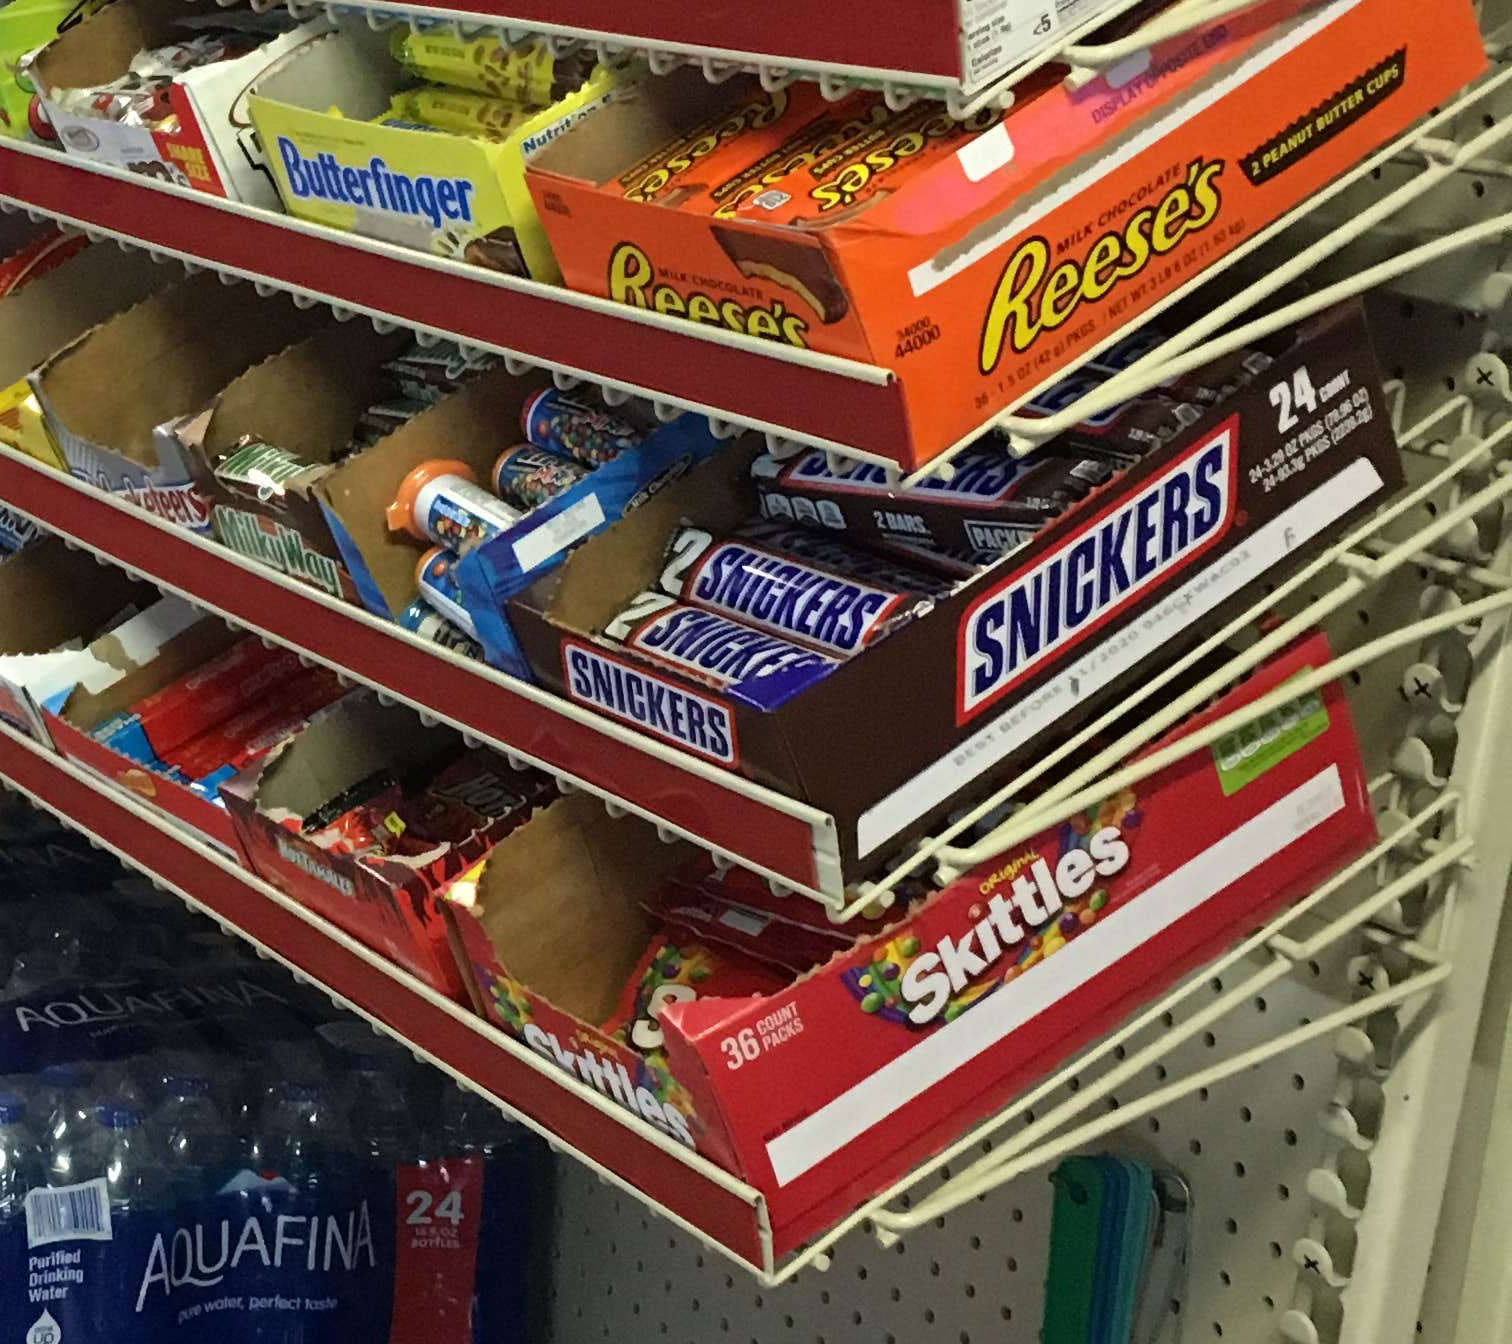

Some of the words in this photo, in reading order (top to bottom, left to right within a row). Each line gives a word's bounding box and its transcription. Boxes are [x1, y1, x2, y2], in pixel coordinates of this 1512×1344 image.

[1091, 83, 1145, 125] DISPLAY
[1252, 163, 1261, 176] 2
[1263, 123, 1314, 166] PEANUT
[1316, 90, 1364, 132] BUTTER
[1366, 63, 1400, 94] CUPS
[277, 136, 472, 229] Butterfinger
[1056, 223, 1093, 256] MILK
[1097, 163, 1183, 228] CHOCOLATE
[658, 268, 688, 282] MILK
[691, 275, 763, 300] CHOCOLATE
[979, 157, 1225, 376] Reese's
[608, 240, 809, 349] Reese's
[894, 324, 940, 358] 44000
[1017, 363, 1033, 380] OZ
[1066, 319, 1096, 348] PKGS
[1108, 297, 1130, 320] NET
[1131, 284, 1148, 304] WT
[1159, 268, 1173, 284] LB
[1269, 365, 1317, 434] 24
[1298, 420, 1324, 447] PKGS
[1305, 435, 1330, 462] PKGS
[874, 511, 886, 529] 2
[887, 513, 926, 534] BARS
[661, 531, 713, 595] 2
[970, 444, 1227, 697] SNICKERS
[605, 593, 676, 641] 2
[694, 543, 886, 652] SNICKERS
[571, 650, 730, 759] SNICKERS
[999, 685, 1063, 733] BEFORE
[978, 850, 1040, 896] ORIGINAL
[902, 825, 1129, 1026] Skittles
[16, 979, 287, 1032] AQUAFINA
[720, 1028, 761, 1071] 36
[756, 1001, 799, 1037] COUNT
[762, 1018, 804, 1053] PACKS
[524, 1023, 696, 1149] Skittles
[406, 1189, 465, 1225] 24
[134, 1199, 377, 1313] AQUAFINA
[411, 1237, 460, 1249] BOTTLES
[440, 1228, 459, 1236] OZ
[29, 1249, 81, 1271] Purified
[29, 1268, 84, 1288] Drinking
[29, 1286, 69, 1303] Water
[205, 1296, 245, 1315] water,
[249, 1292, 295, 1313] perfect
